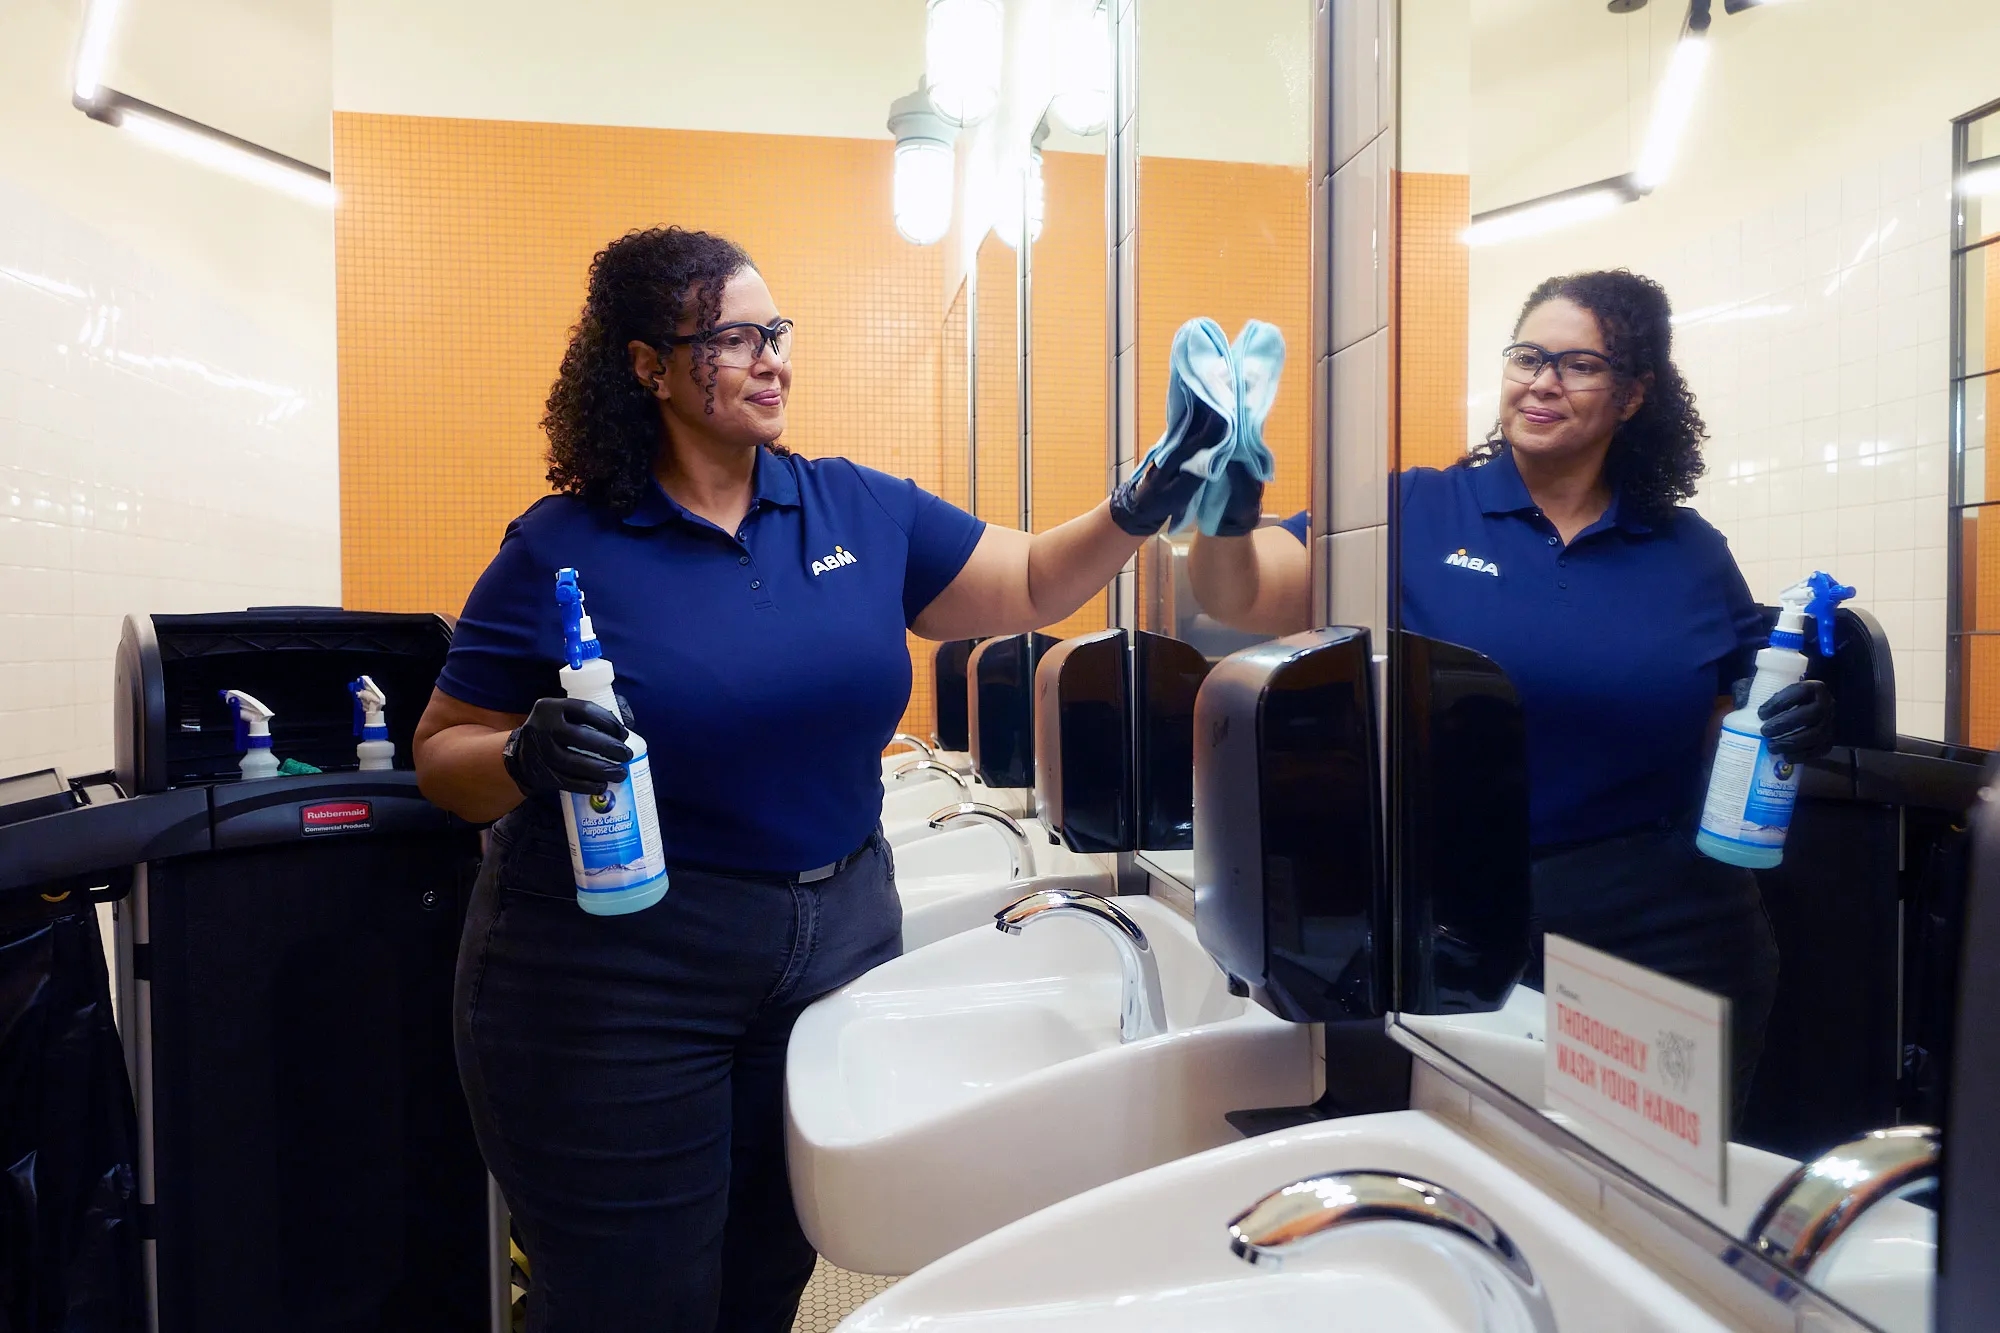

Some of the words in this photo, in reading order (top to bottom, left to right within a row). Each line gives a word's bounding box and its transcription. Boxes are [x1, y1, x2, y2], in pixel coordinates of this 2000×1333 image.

[811, 547, 858, 577] ABM
[307, 808, 366, 819] Rubbermaid
[581, 817, 598, 827] Glass
[604, 811, 630, 825] General
[582, 826, 608, 838] Purpose
[608, 821, 633, 833] Cleaner
[1556, 1002, 1648, 1074] THOROUGHLY
[1556, 1042, 1597, 1089] WASH
[1600, 1064, 1639, 1113] YOUR
[1643, 1087, 1702, 1150] HANDS
